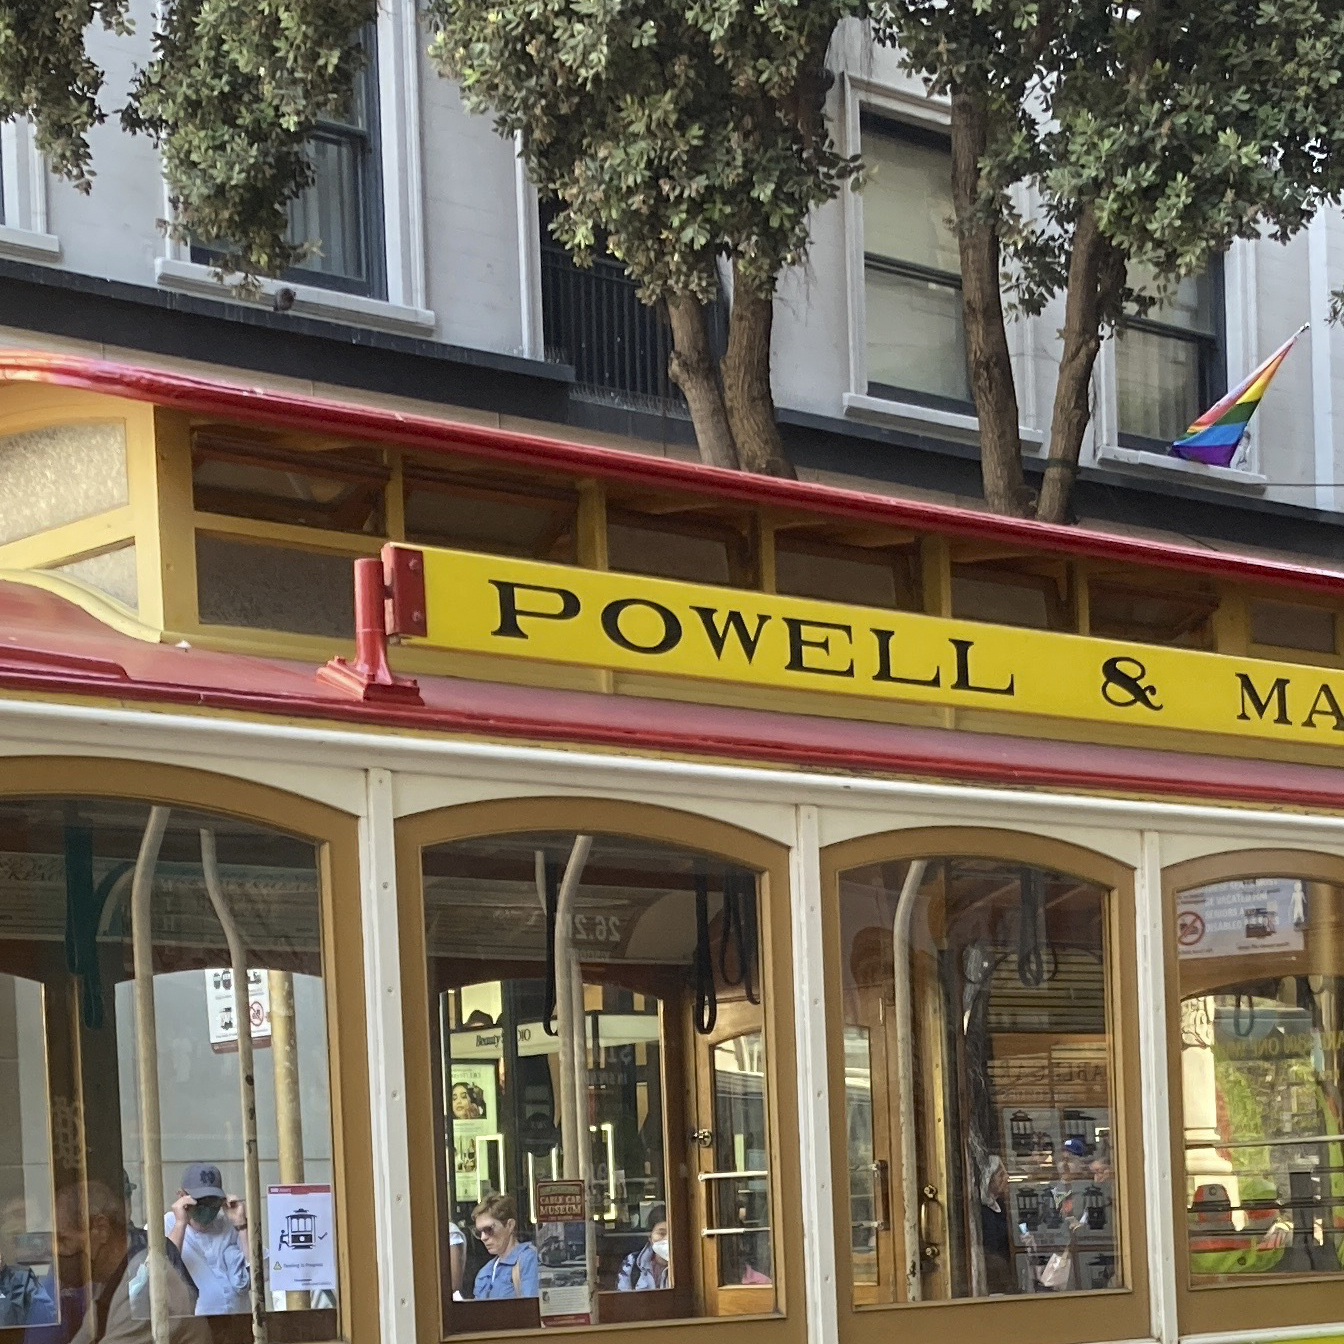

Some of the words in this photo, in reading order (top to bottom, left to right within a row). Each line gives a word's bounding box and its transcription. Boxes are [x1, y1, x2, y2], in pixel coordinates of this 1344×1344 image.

[488, 579, 1015, 697] POWELL
[1100, 655, 1163, 712] &
[539, 1204, 582, 1216] MUSEUM
